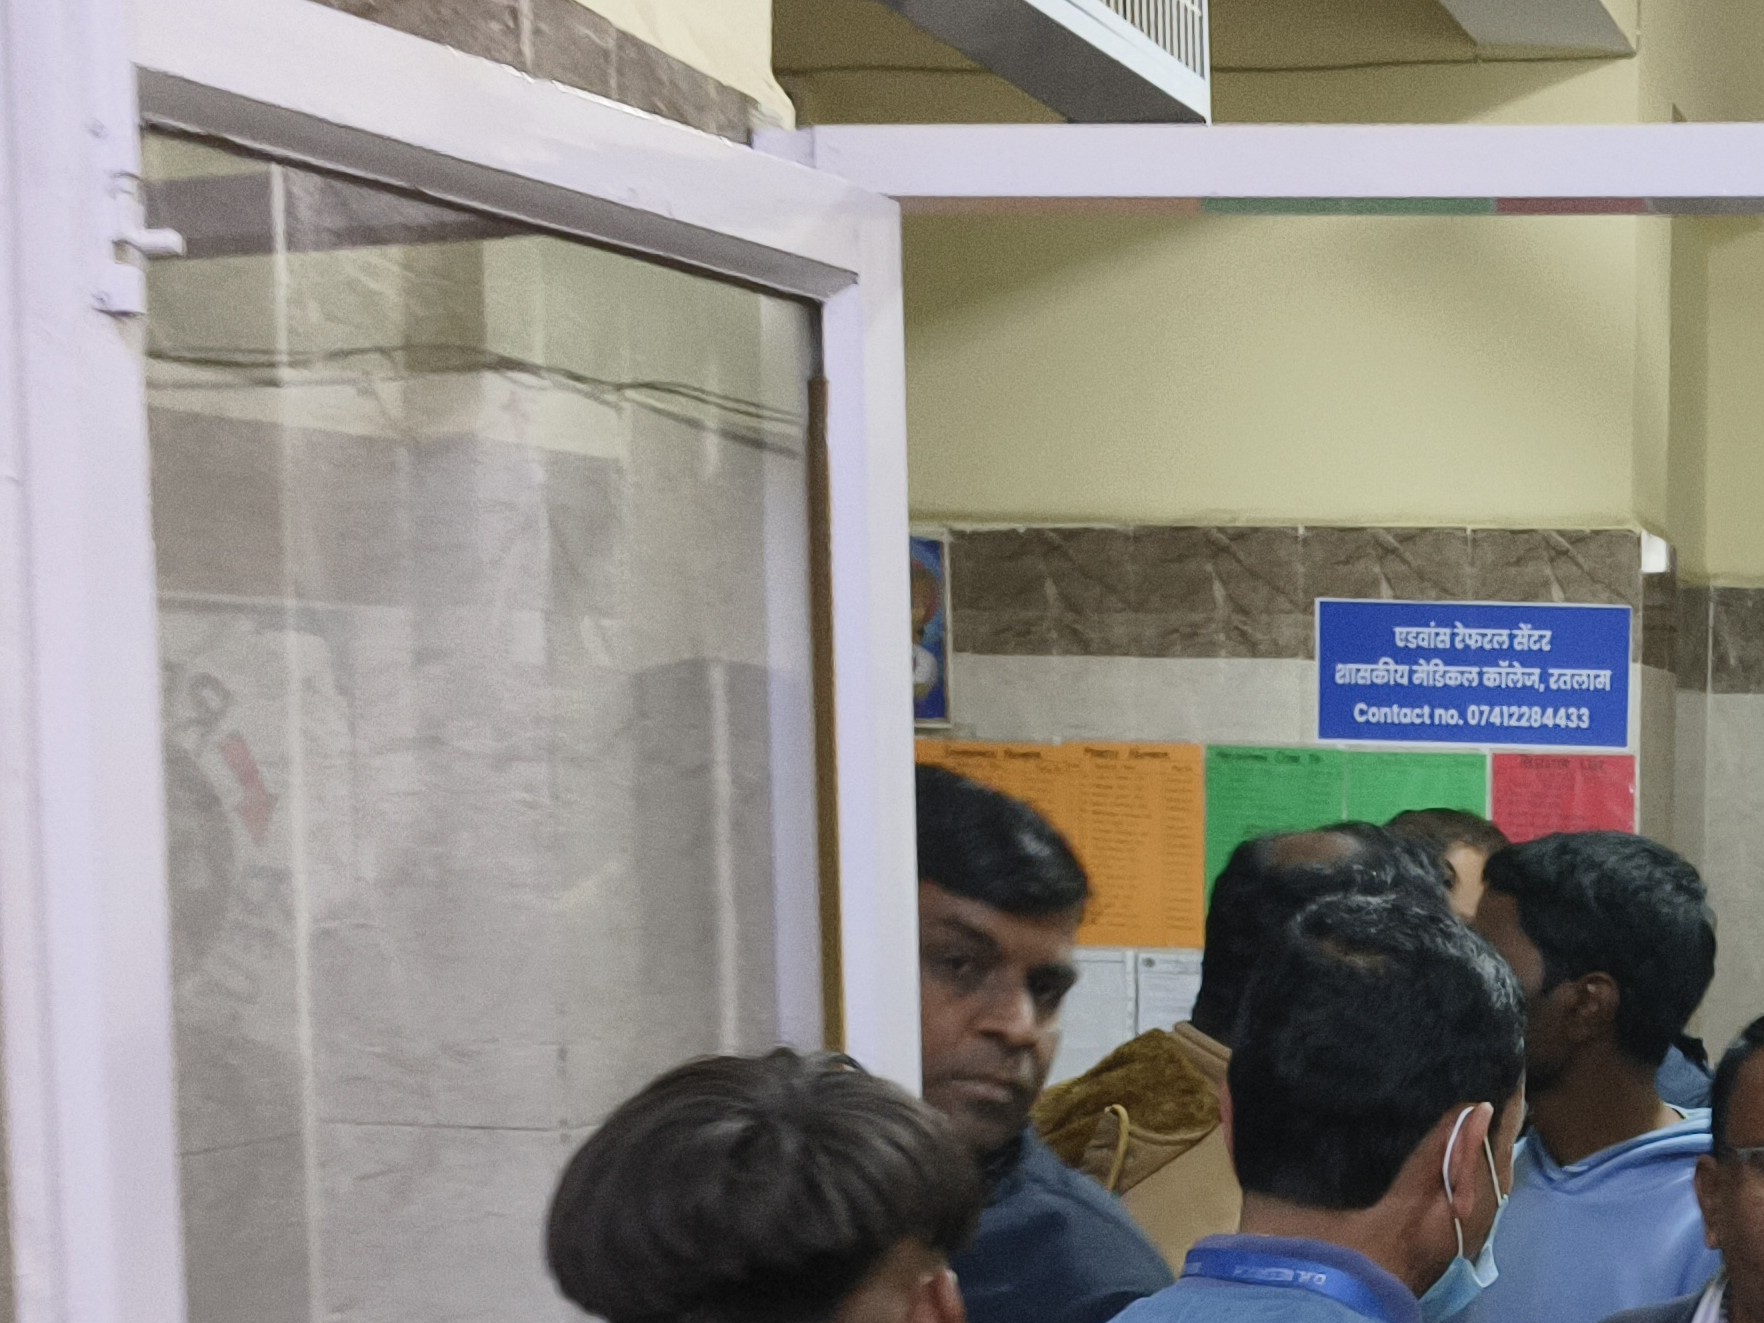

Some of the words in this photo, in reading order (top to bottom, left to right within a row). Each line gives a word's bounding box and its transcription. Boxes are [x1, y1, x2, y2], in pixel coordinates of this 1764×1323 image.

[1393, 620, 1451, 649] एडवांस
[1453, 621, 1510, 650] रेफरल
[1511, 622, 1552, 651] सेंटर
[1335, 656, 1410, 686] शासकीय
[1411, 658, 1480, 687] मेडिकल
[1482, 660, 1545, 692] कॉलेज,
[1547, 668, 1612, 691] रतलाम
[1353, 702, 1431, 725] Contact
[1433, 707, 1464, 726] no.
[1466, 705, 1590, 729] 07412284433
